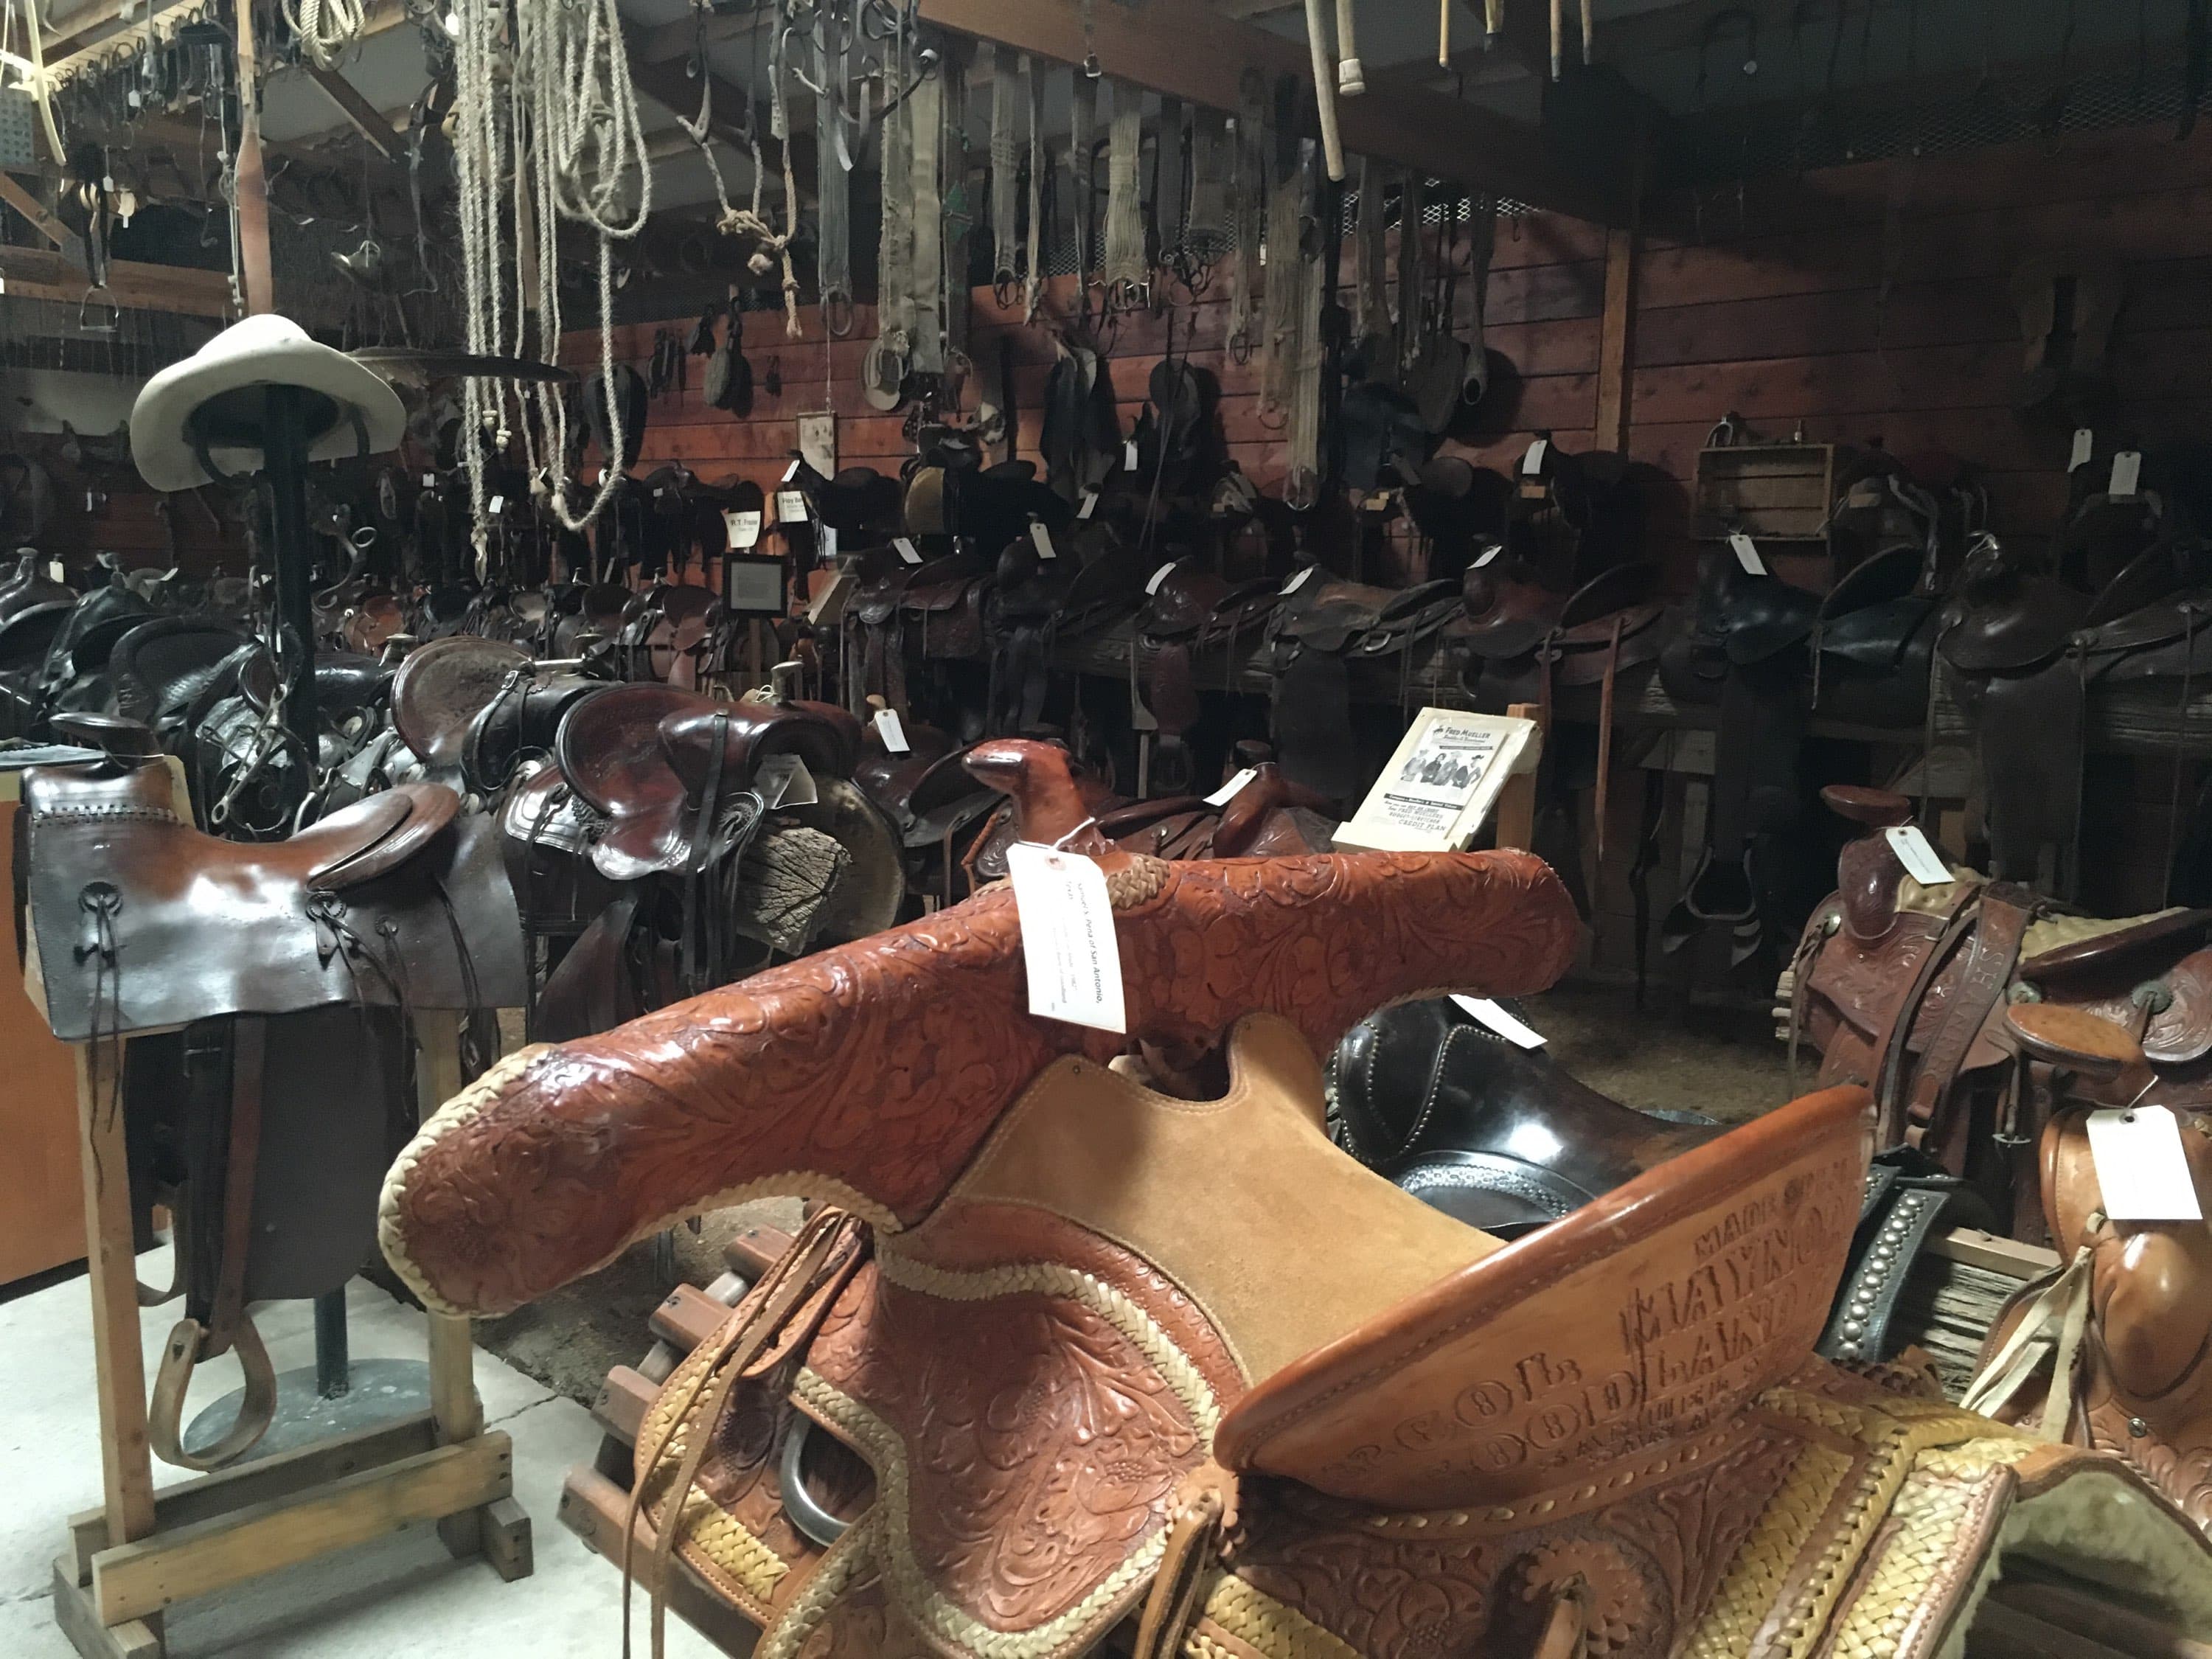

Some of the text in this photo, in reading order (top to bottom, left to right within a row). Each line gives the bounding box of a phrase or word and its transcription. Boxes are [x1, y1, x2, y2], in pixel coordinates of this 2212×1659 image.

[1445, 726, 1460, 735] FRED
[1461, 728, 1491, 739] MUELLER
[1088, 939, 1097, 948] of
[1093, 967, 1103, 1004] Antonio,
